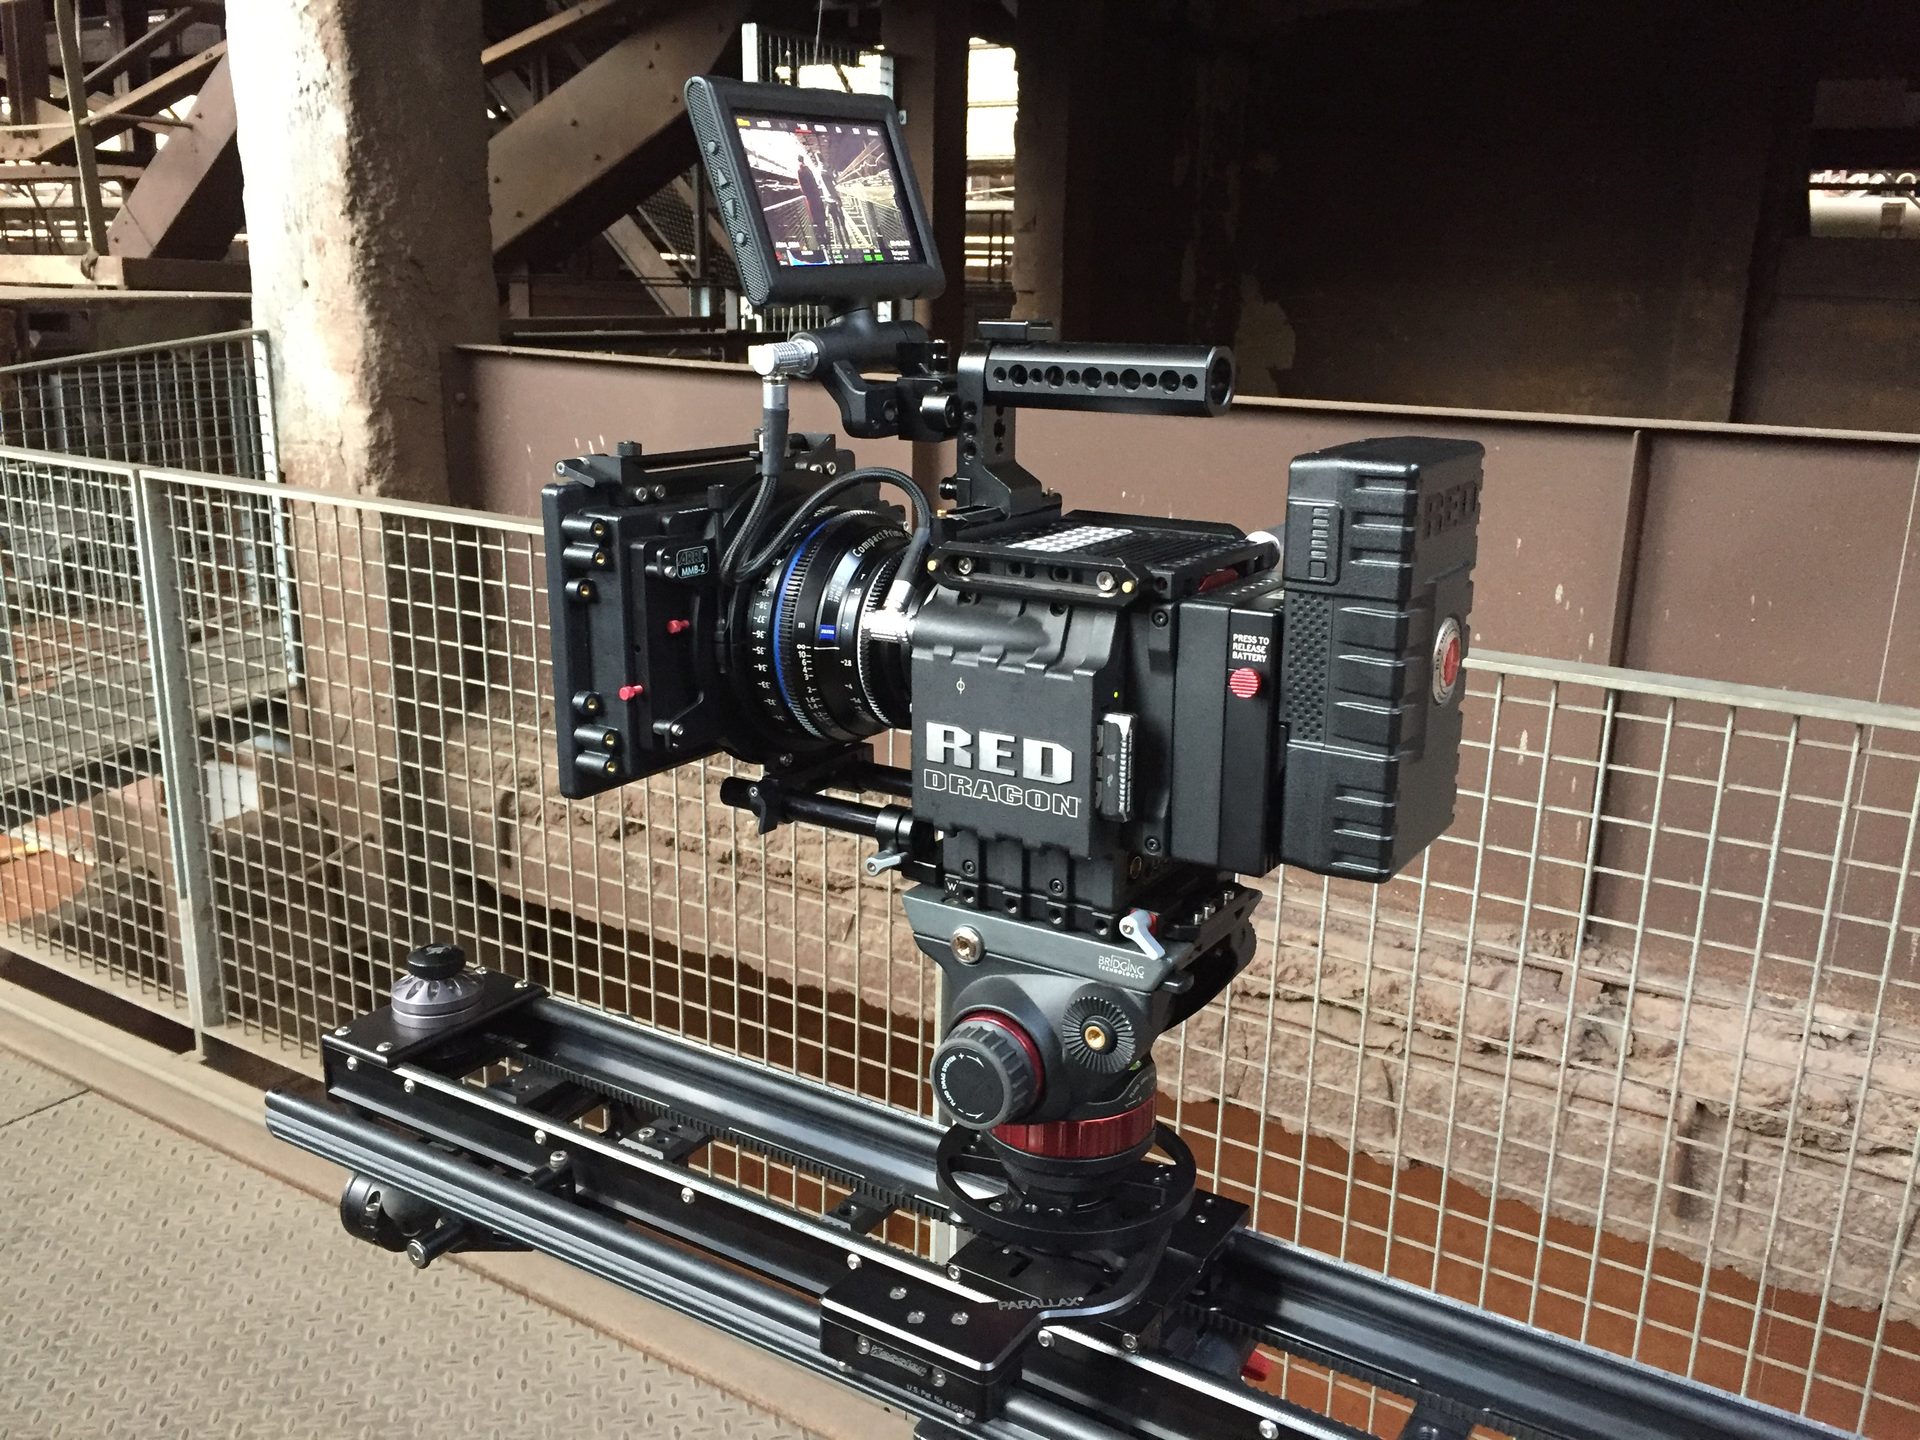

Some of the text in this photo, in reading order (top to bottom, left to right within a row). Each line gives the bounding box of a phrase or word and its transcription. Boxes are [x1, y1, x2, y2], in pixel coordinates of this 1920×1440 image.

[1423, 481, 1478, 538] RED
[852, 531, 886, 557] Compact
[682, 563, 705, 577] MMB-2
[1232, 642, 1267, 654] RELEASE
[1233, 633, 1270, 646] PRESS TO
[1232, 650, 1267, 663] BATTERY
[926, 720, 1073, 785] RED
[923, 768, 1079, 819] DRAGON
[1098, 954, 1145, 976] BRIDGING
[941, 1054, 957, 1073] SYSTEM
[940, 1072, 948, 1090] DRAG
[997, 1296, 1080, 1311] PARALLAX
